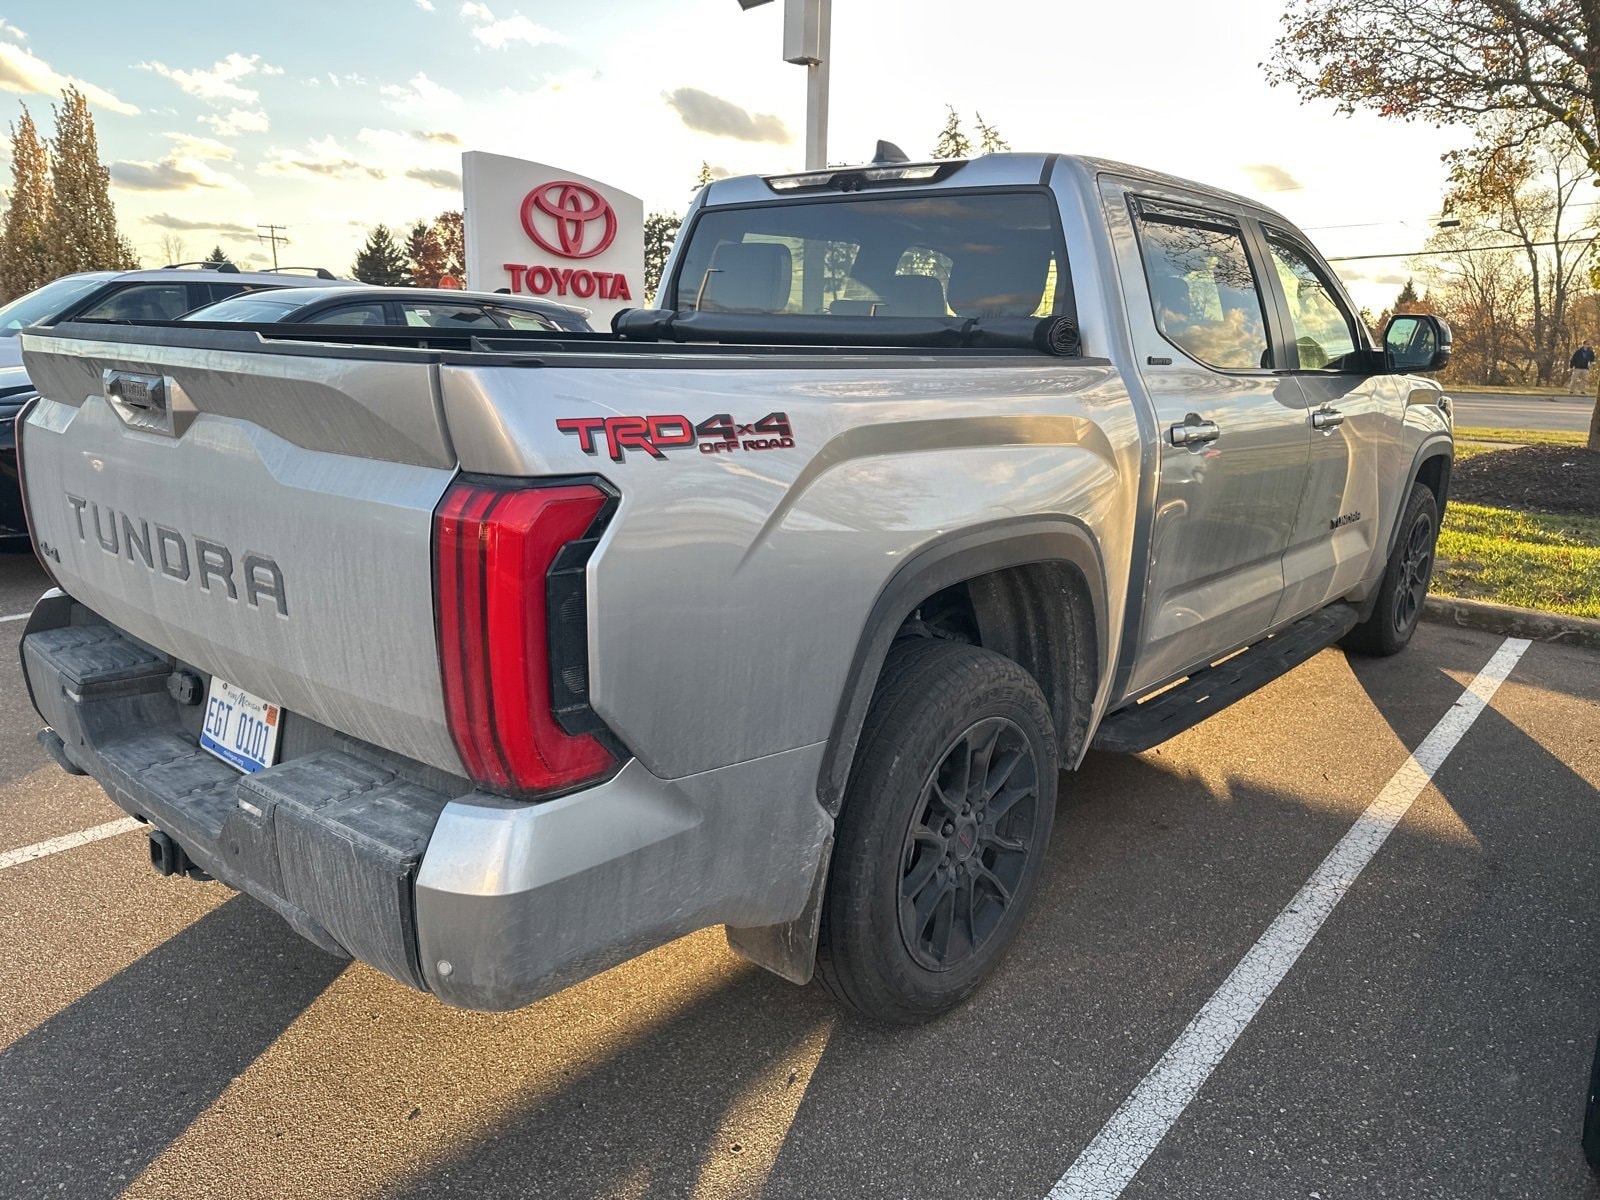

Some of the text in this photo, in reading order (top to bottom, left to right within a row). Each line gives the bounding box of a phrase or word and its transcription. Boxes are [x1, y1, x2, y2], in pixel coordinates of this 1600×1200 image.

[503, 263, 632, 300] TOYOTA
[556, 412, 793, 464] TRD 4x4
[699, 437, 796, 454] OFF ROAD
[65, 493, 288, 619] TUNDRA
[205, 697, 233, 740] EGT
[236, 712, 269, 765] 0101
